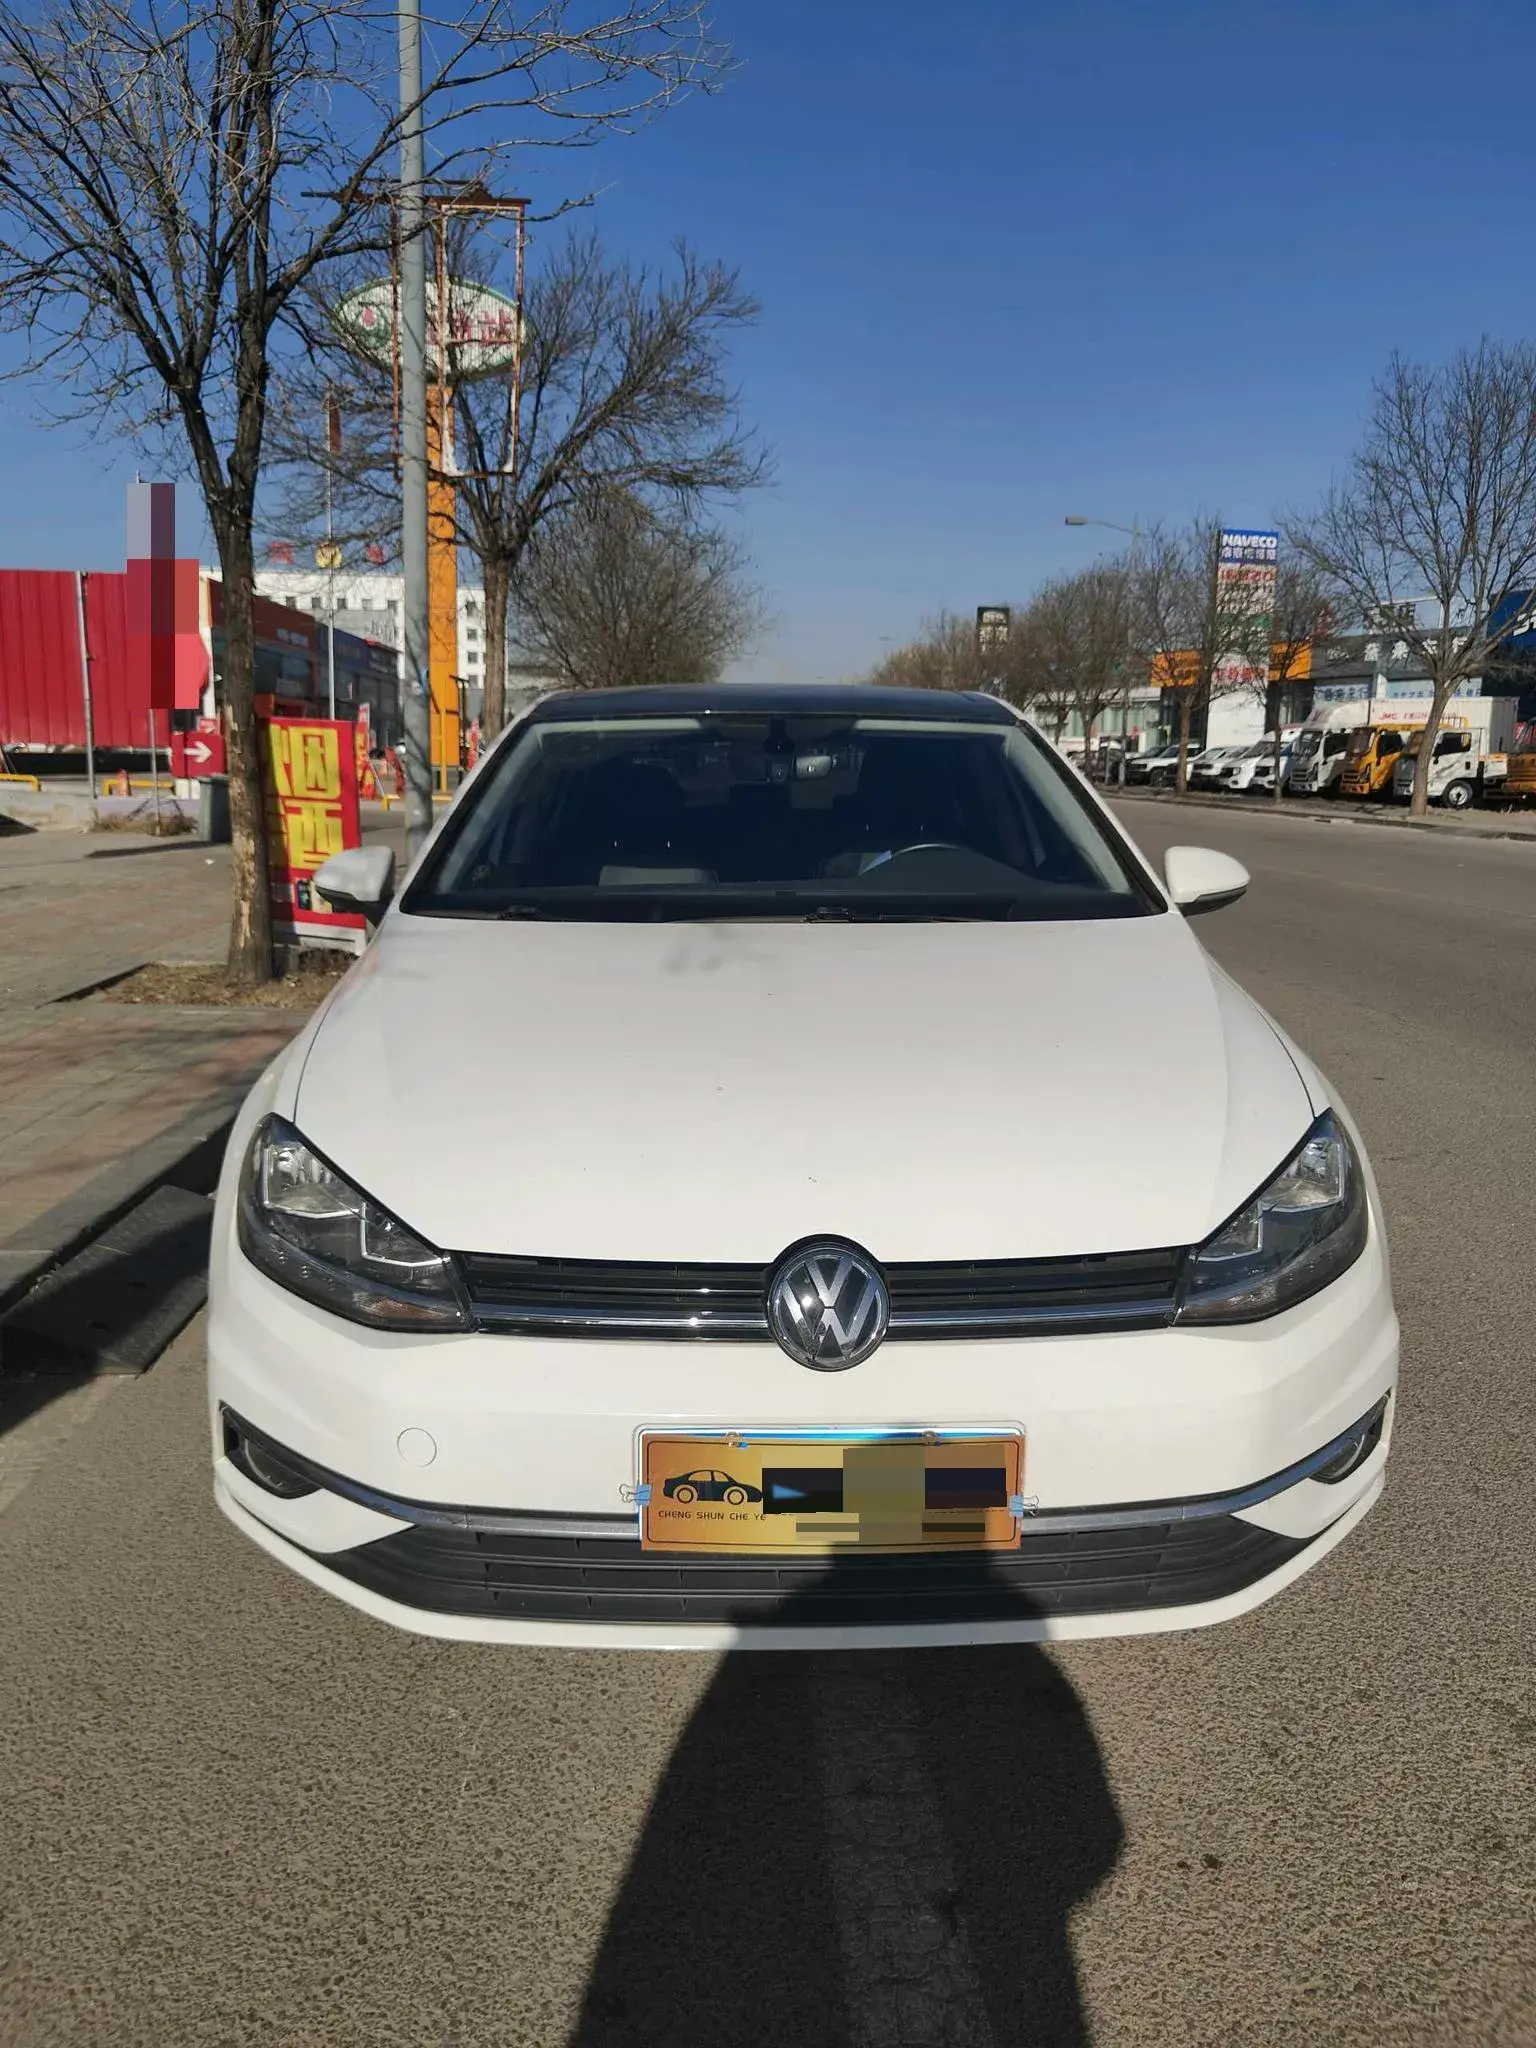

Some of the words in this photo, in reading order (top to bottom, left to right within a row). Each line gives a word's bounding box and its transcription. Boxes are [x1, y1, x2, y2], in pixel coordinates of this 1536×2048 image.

[1222, 534, 1278, 548] NAVECO
[658, 1510, 692, 1519] CHENG
[696, 1511, 725, 1520] SHUN
[729, 1512, 748, 1521] CHE
